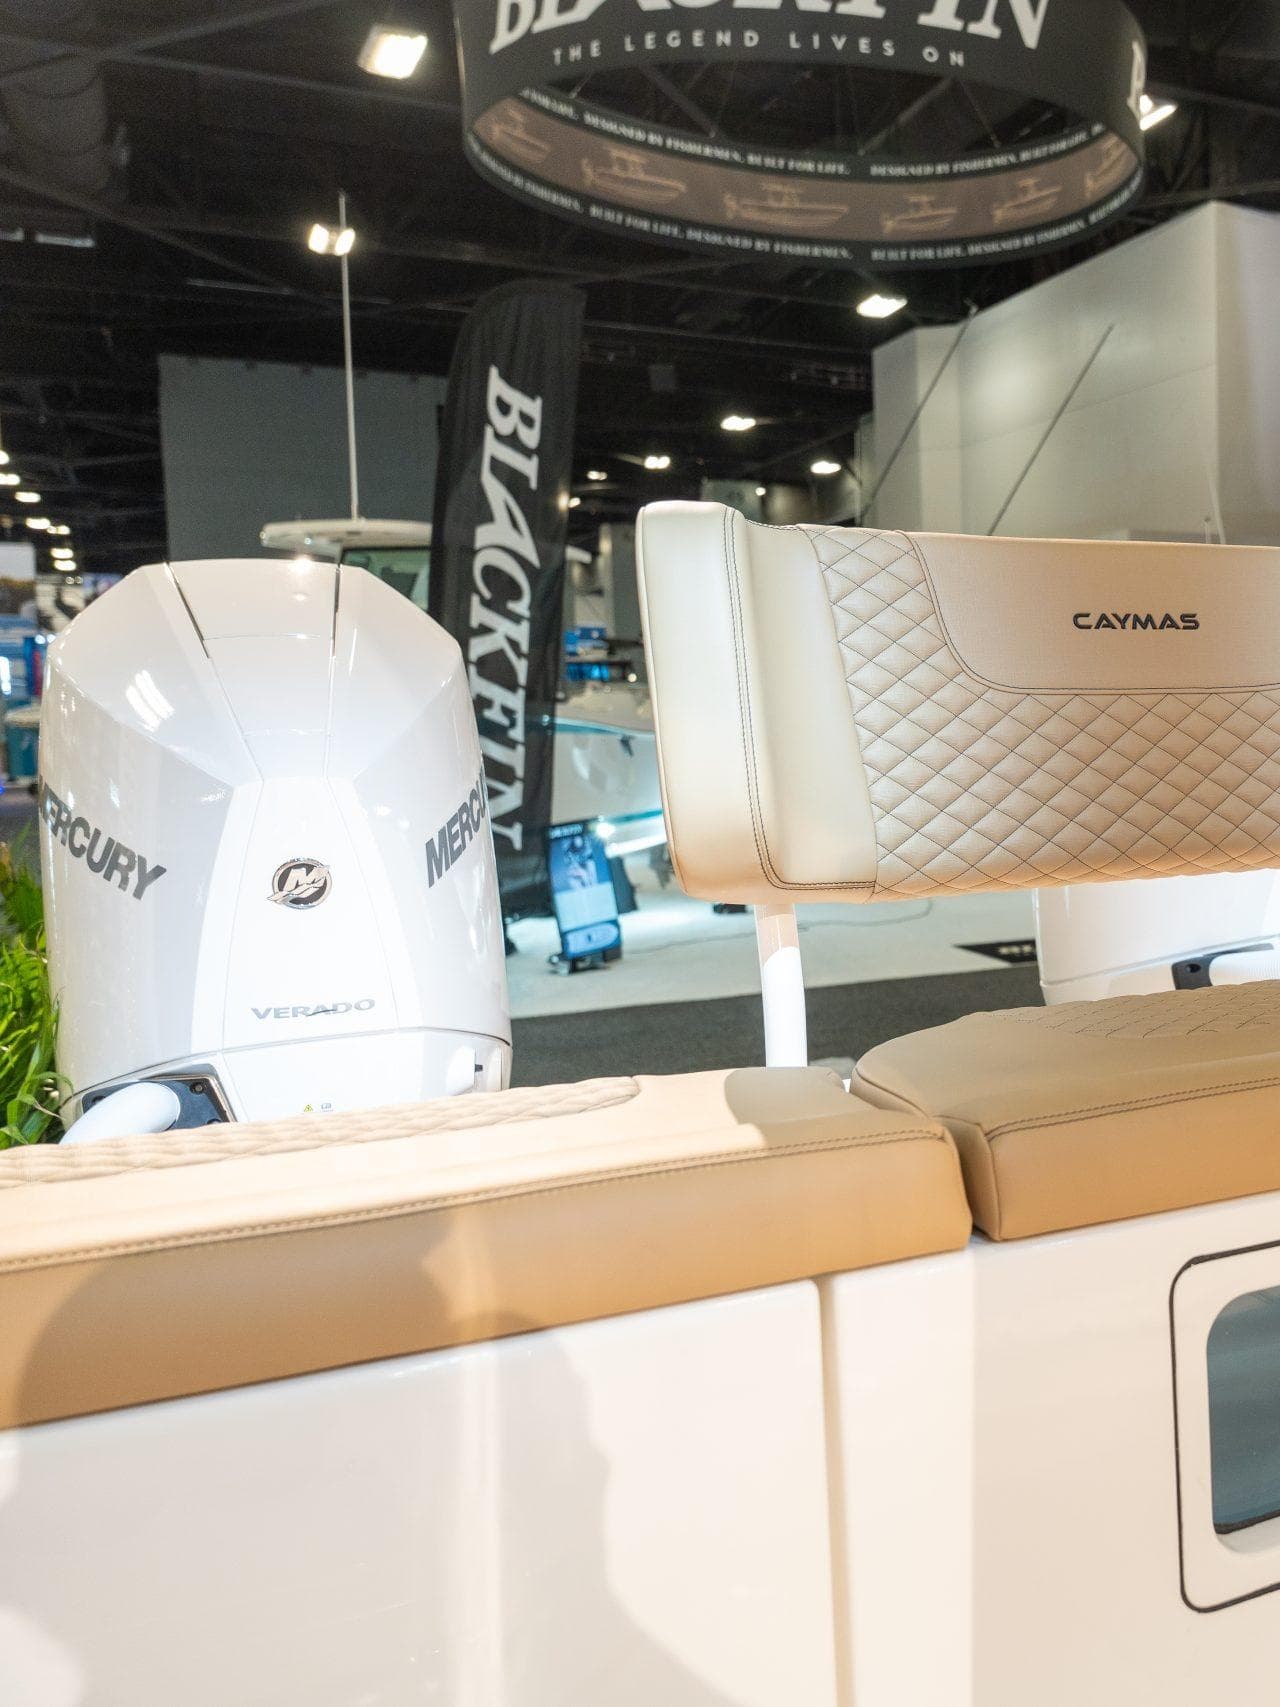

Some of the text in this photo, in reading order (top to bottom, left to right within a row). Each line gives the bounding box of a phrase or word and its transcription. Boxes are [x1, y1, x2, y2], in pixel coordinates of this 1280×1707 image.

[553, 29, 964, 67] THE LEGEND LIVES ON
[468, 365, 543, 852] BLACKFIN
[1072, 612, 1200, 630] CAYMAS
[251, 998, 376, 1020] VERADO
